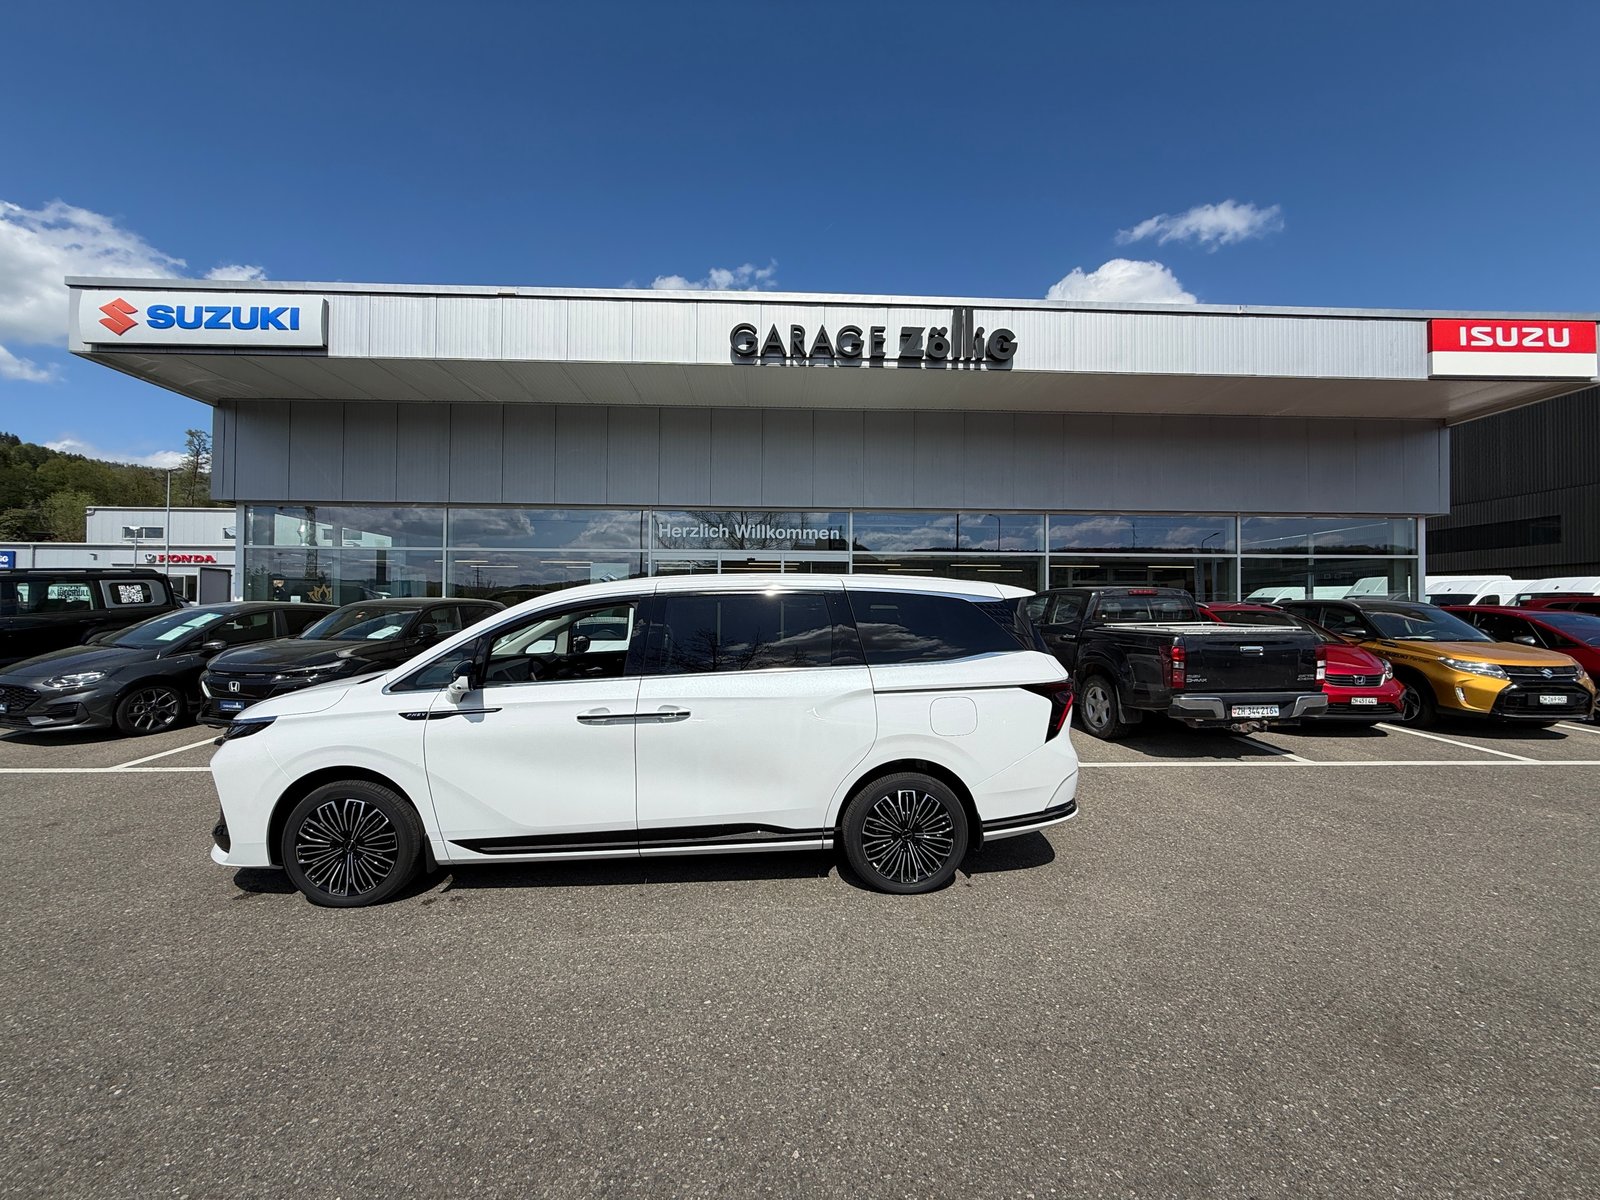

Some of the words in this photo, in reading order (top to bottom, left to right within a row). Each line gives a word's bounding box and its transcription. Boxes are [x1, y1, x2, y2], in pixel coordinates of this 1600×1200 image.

[146, 304, 300, 331] SUZUKI
[729, 322, 887, 358] GARAGE
[1459, 325, 1570, 348] ISUZU
[658, 523, 729, 539] Herzlich
[734, 524, 841, 541] Willkommen
[157, 553, 217, 564] HONDA
